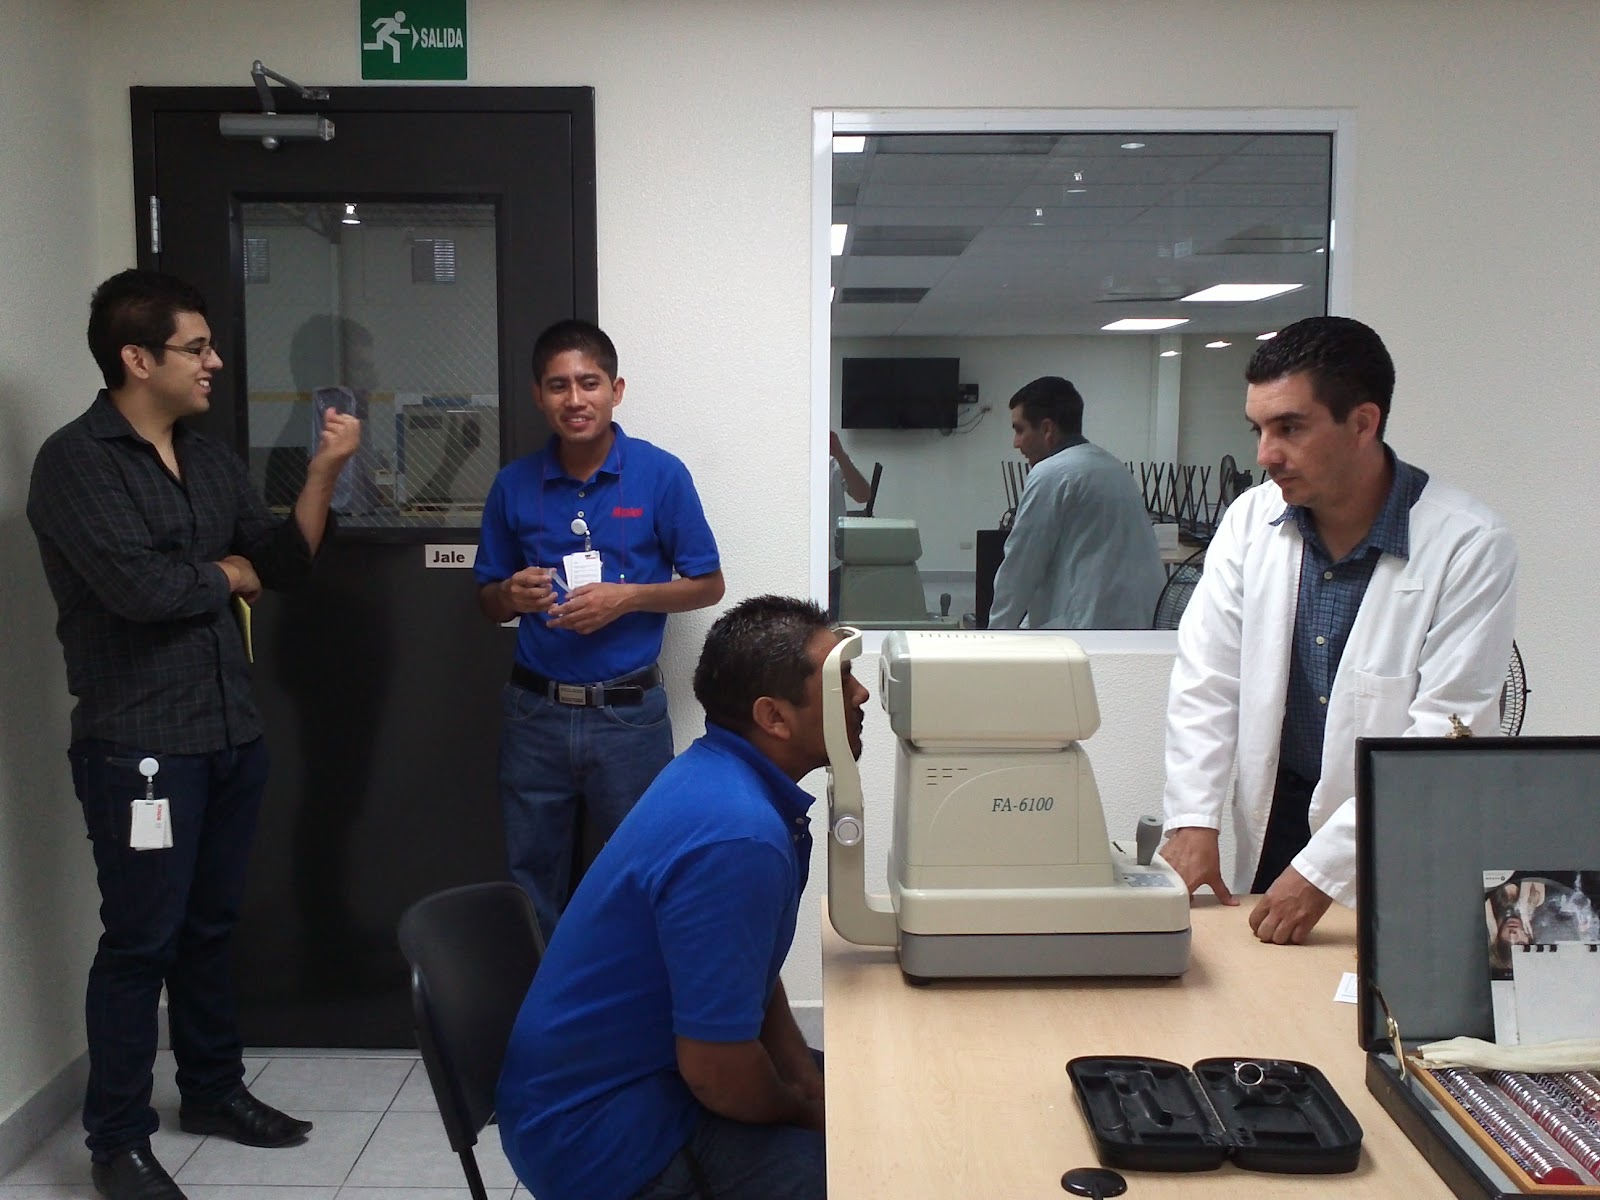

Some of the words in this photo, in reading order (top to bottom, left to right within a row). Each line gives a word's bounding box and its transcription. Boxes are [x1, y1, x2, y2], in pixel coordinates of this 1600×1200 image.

[421, 28, 463, 48] SALIDA
[433, 551, 465, 563] Jale
[992, 797, 1054, 812] FA-6100
